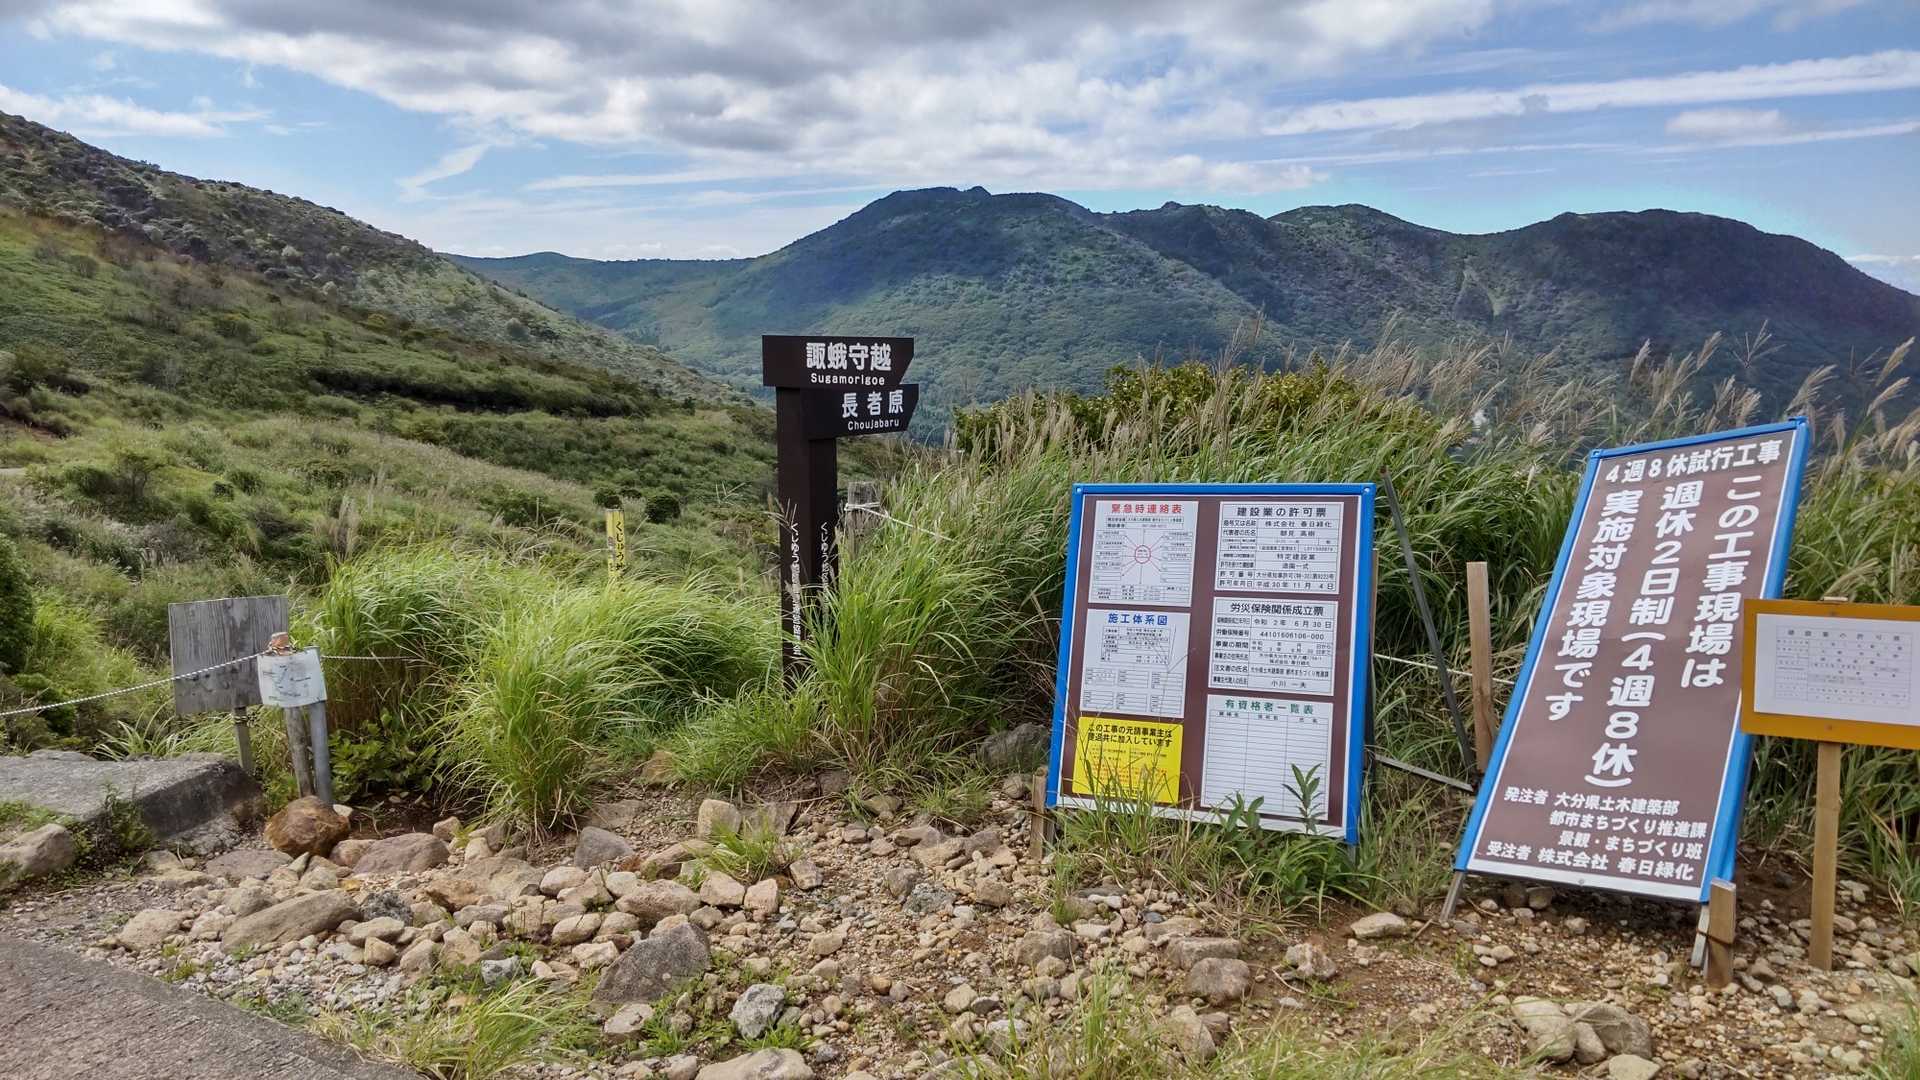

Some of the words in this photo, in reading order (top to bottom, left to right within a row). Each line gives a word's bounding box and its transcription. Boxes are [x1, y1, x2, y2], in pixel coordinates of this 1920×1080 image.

[805, 342, 892, 372] 諏蛾守越
[810, 373, 885, 386] Sugamorigoe
[841, 390, 904, 419] 長者原
[848, 419, 900, 431] Choujabaru
[1237, 507, 1326, 517] 建設業の許可票
[1680, 475, 1762, 687] この工事現場は
[1108, 613, 1168, 625] 施工体系図
[1230, 602, 1324, 616] 労災保険関係成立票
[1545, 489, 1643, 720] 実施対象現場です
[1503, 786, 1549, 805] 発注者
[1554, 791, 1681, 817] 大分県土木建築部
[1550, 810, 1708, 839] 都市まちづくり推進課
[1558, 830, 1704, 860] 景観・まちづくり班
[1485, 840, 1532, 860] 受注者
[1537, 847, 1609, 871] 株式会社
[1617, 857, 1695, 881] 春日緑化
